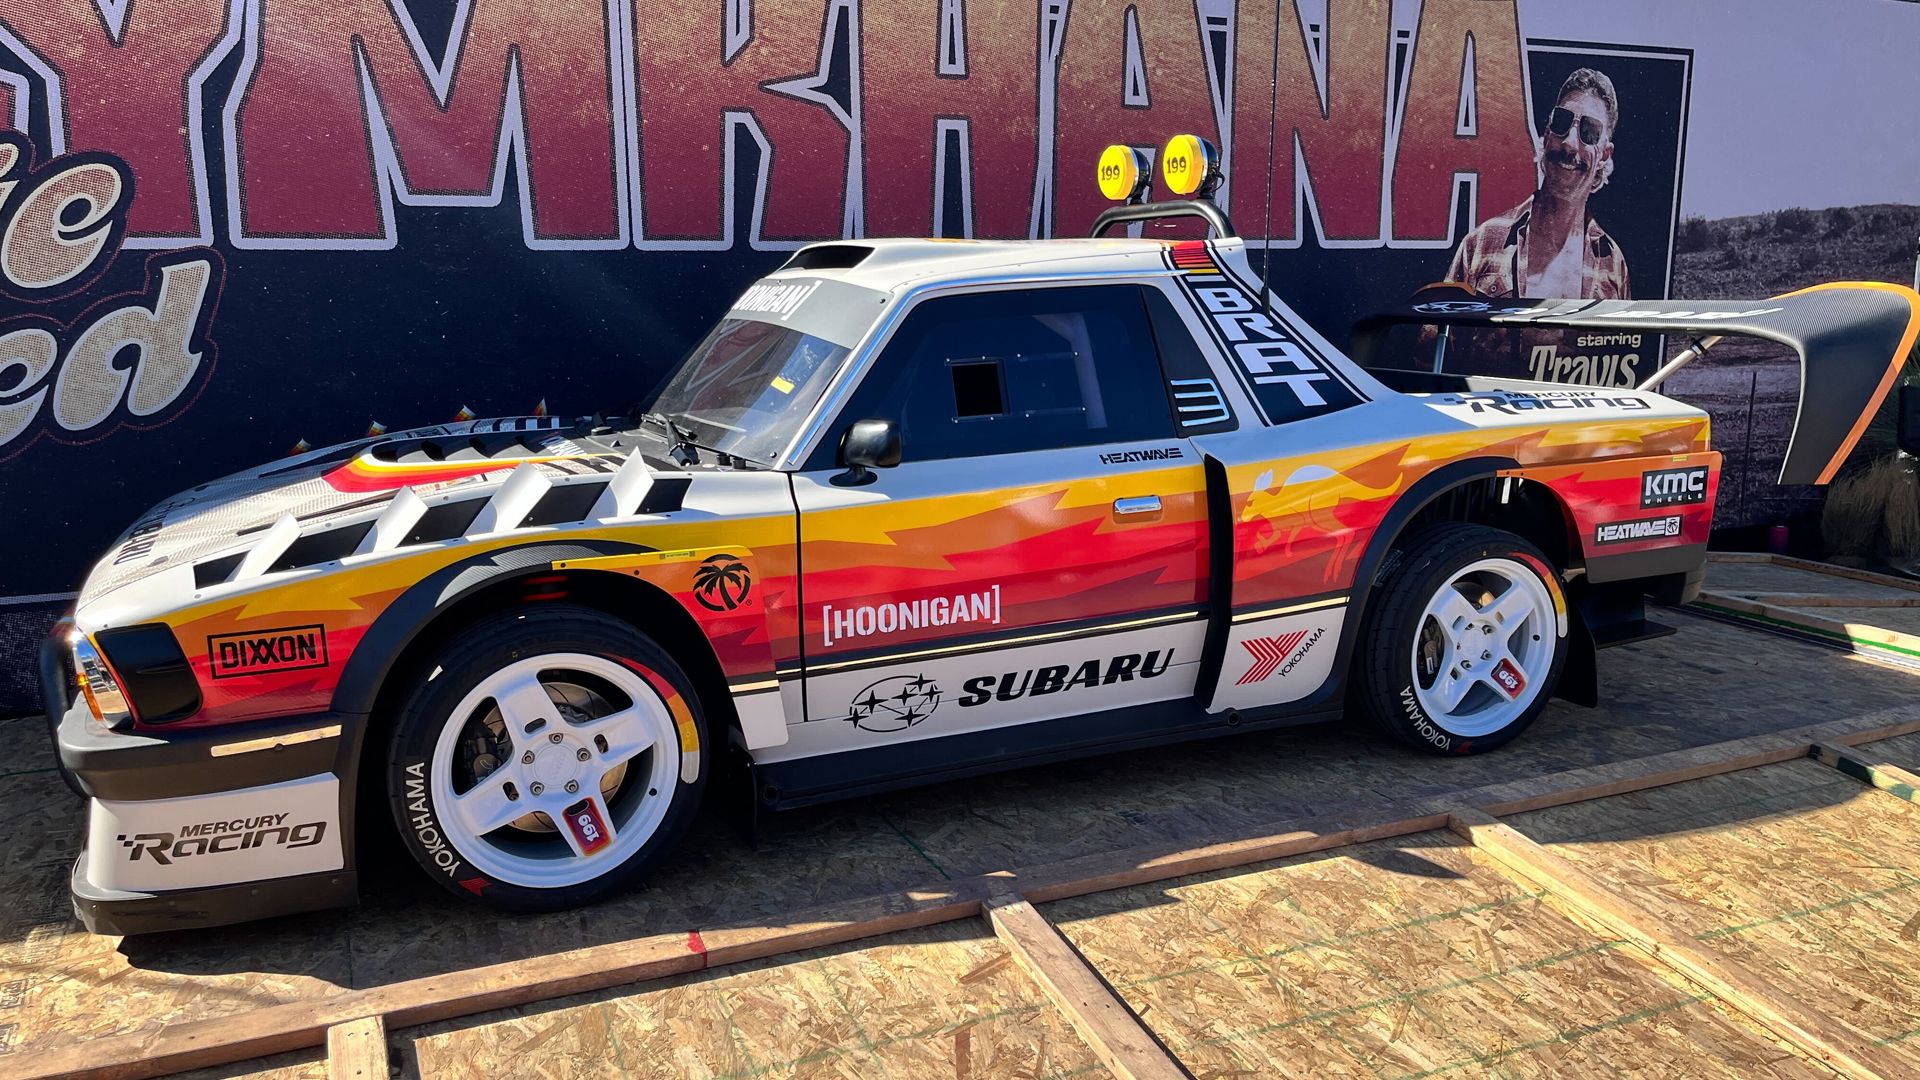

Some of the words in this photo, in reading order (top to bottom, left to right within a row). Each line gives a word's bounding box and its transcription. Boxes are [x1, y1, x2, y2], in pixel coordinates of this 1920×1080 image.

[0, 0, 1541, 250] YMKHANA
[1101, 164, 1121, 181] 199
[1166, 156, 1187, 174] 199
[1195, 288, 1330, 407] BRAT
[1577, 332, 1642, 348] starring
[1529, 345, 1640, 389] Travis
[1461, 396, 1652, 415] Racing
[1504, 391, 1597, 400] MERCURY
[1099, 447, 1184, 465] HEATWAVE
[1645, 470, 1704, 496] KMC
[1645, 493, 1703, 505] WHEELS
[1597, 520, 1666, 542] HEATWAVE
[823, 584, 1000, 647] [HOONIGAN]
[219, 633, 317, 669] DIXXON
[1278, 627, 1326, 678] YOKOHAMA
[958, 647, 1176, 708] SUBARU
[1400, 685, 1451, 750] YOKOHAMA
[180, 812, 290, 838] MERCURY
[406, 762, 461, 877] YOKOHAMA
[129, 821, 327, 866] Racing
